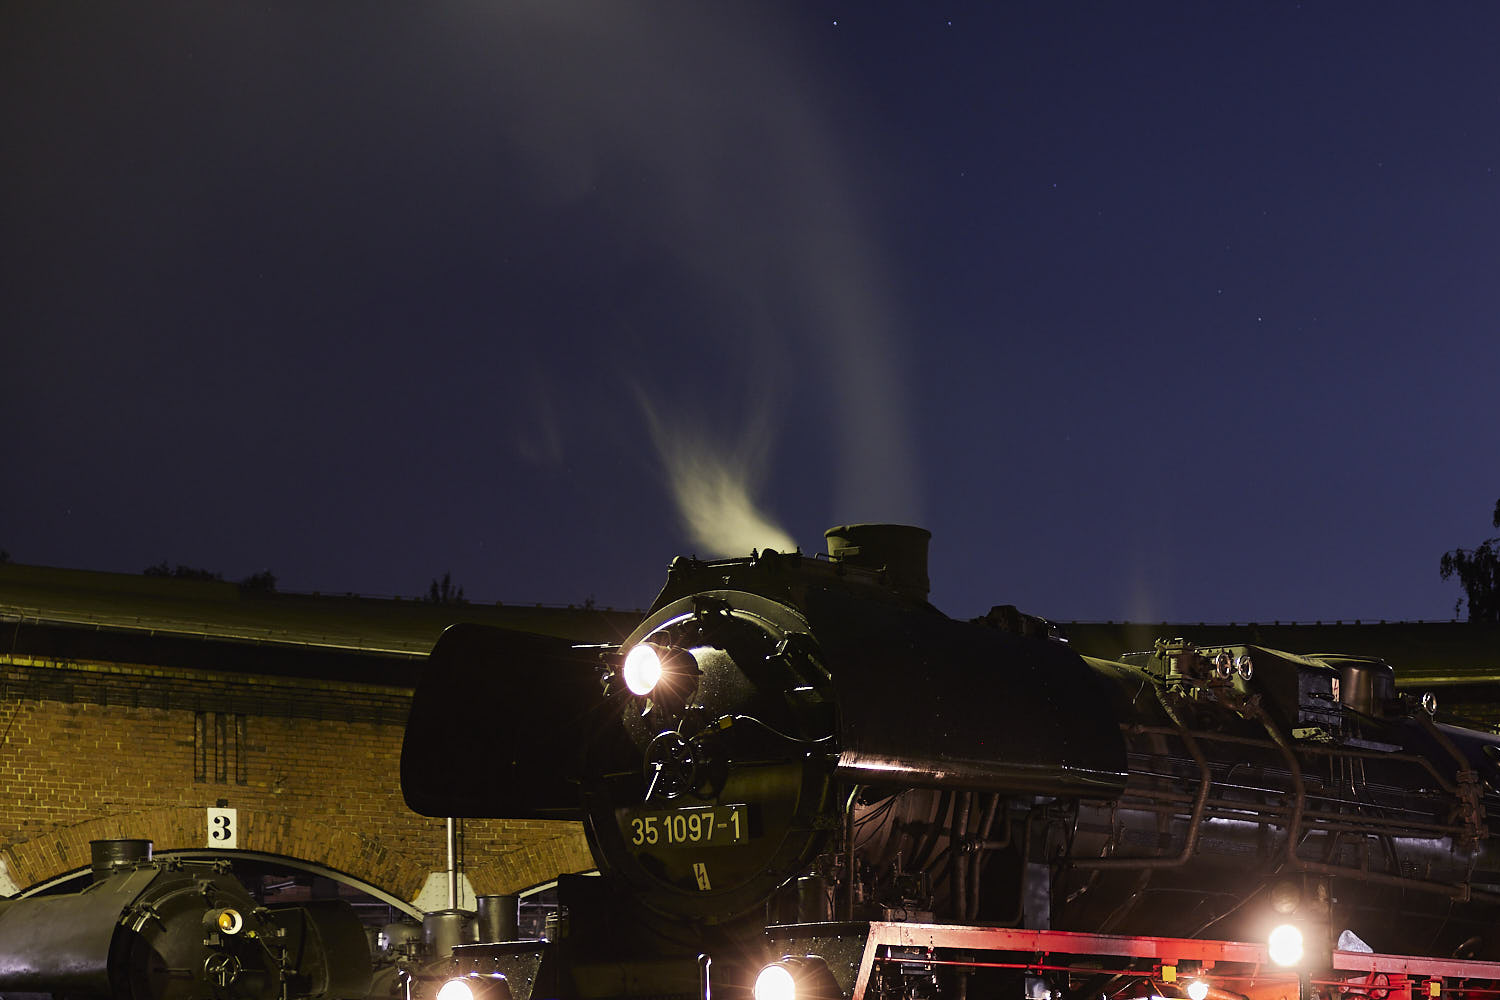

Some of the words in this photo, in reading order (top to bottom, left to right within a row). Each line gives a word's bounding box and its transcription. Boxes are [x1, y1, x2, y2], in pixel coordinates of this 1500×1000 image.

[212, 815, 232, 841] 3
[631, 817, 659, 845] 35
[663, 810, 740, 843] 1097-1
